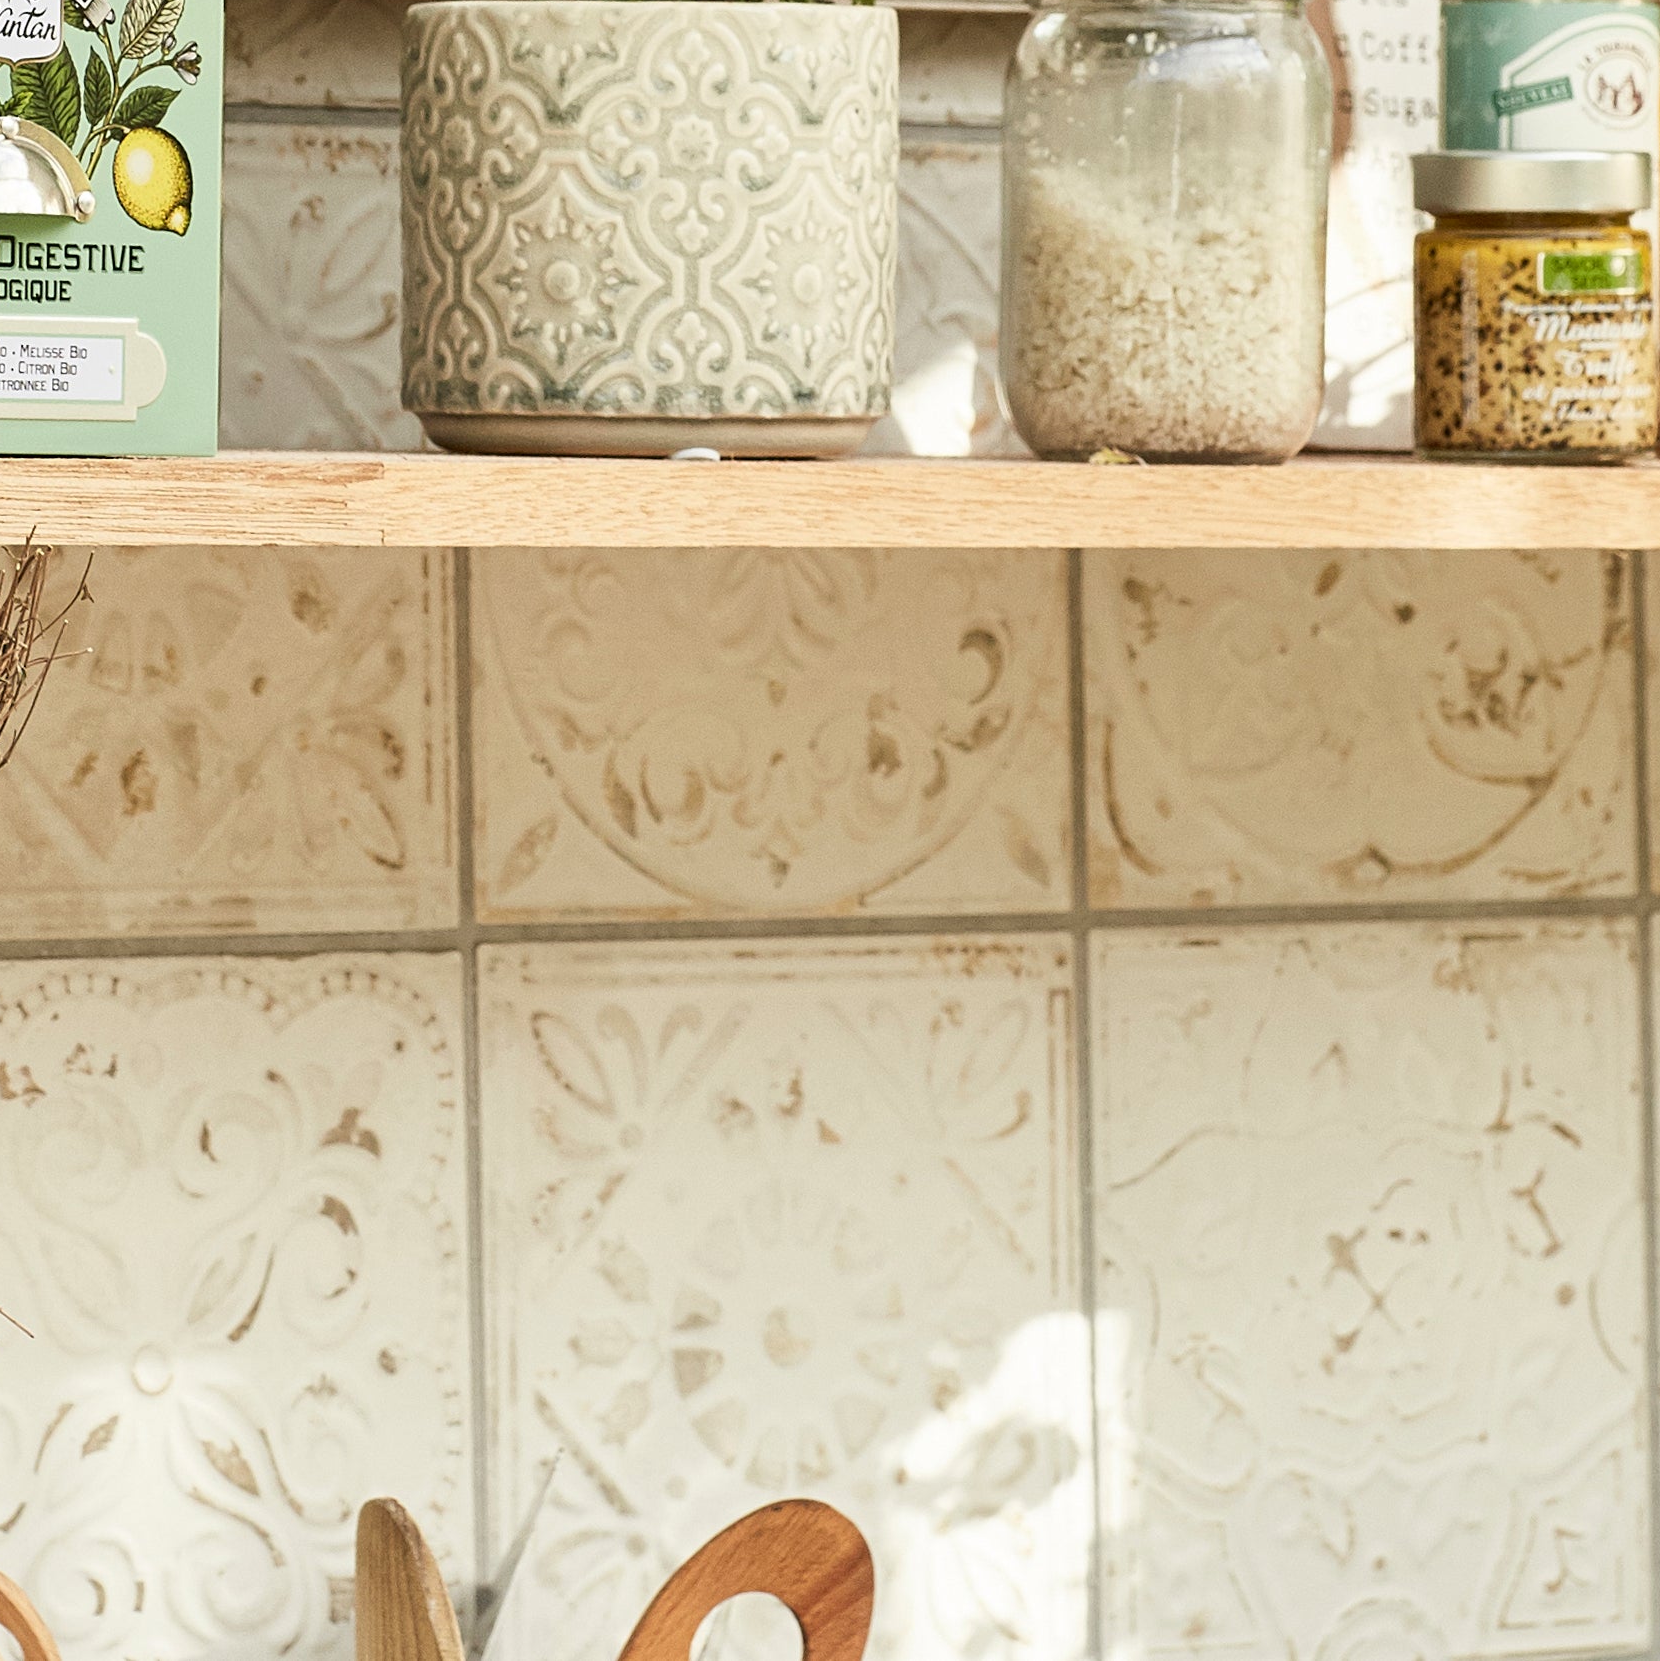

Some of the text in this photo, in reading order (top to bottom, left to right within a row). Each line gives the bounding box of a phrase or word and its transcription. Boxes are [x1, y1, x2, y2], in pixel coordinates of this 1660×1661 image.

[1359, 29, 1435, 64] Coff
[1363, 87, 1439, 128] Suga
[20, 344, 65, 359] MELISSE
[70, 345, 88, 359] BIO
[18, 360, 56, 375] CITRON
[60, 361, 78, 376] BIO
[52, 378, 70, 392] BIO
